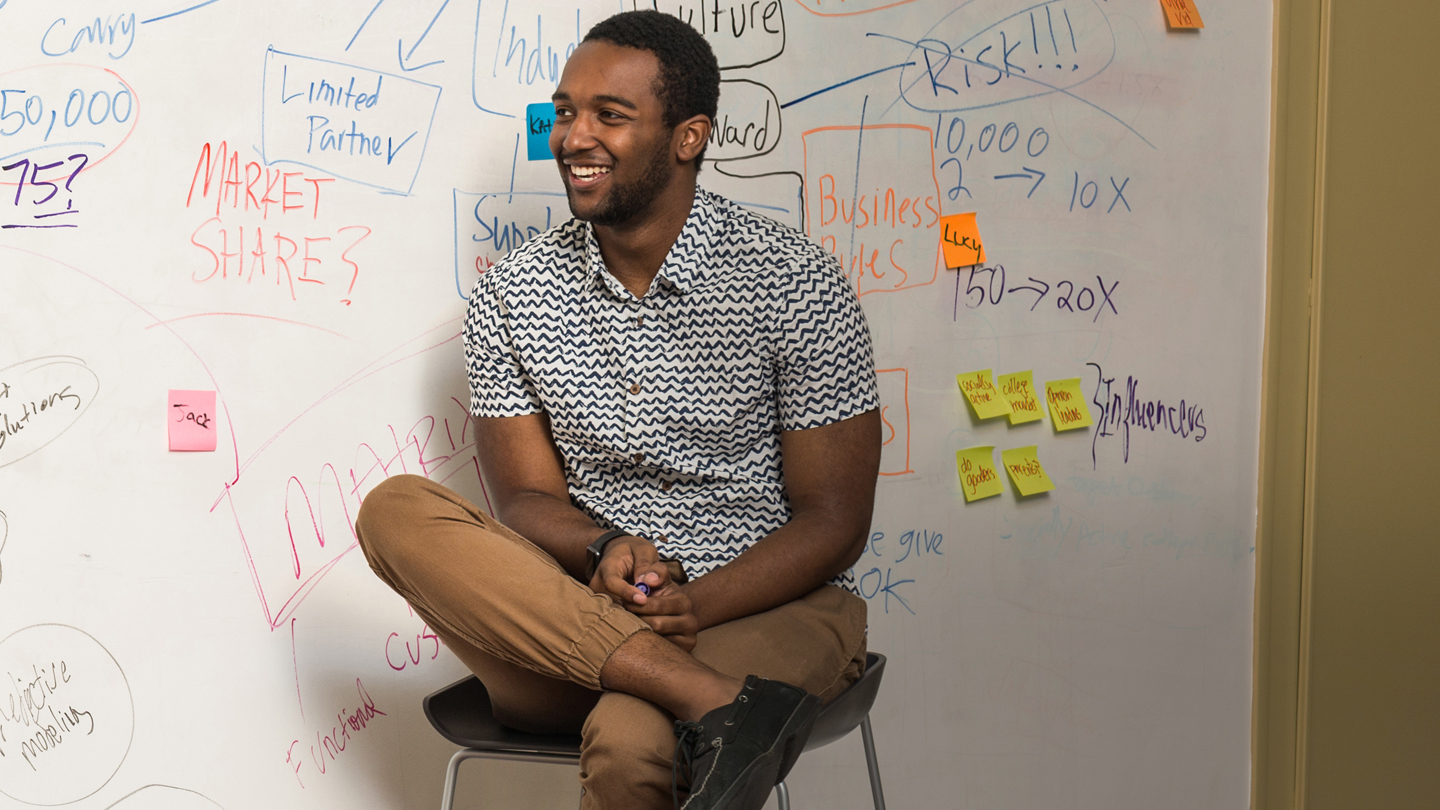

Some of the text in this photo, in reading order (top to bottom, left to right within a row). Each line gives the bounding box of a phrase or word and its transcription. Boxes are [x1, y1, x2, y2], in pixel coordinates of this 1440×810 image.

[653, 0, 781, 38] ulture
[916, 6, 1079, 96] Risk!!!
[282, 65, 383, 111] Limited
[306, 115, 418, 165] Partner
[709, 99, 770, 151] ward
[934, 113, 1049, 161] 10,000
[1, 153, 88, 210] 75?
[186, 140, 336, 221] MARKET
[819, 174, 940, 229] Business
[940, 157, 972, 201] 2
[191, 216, 371, 306] SHARE?
[173, 403, 211, 430] Jack
[895, 529, 945, 563] give
